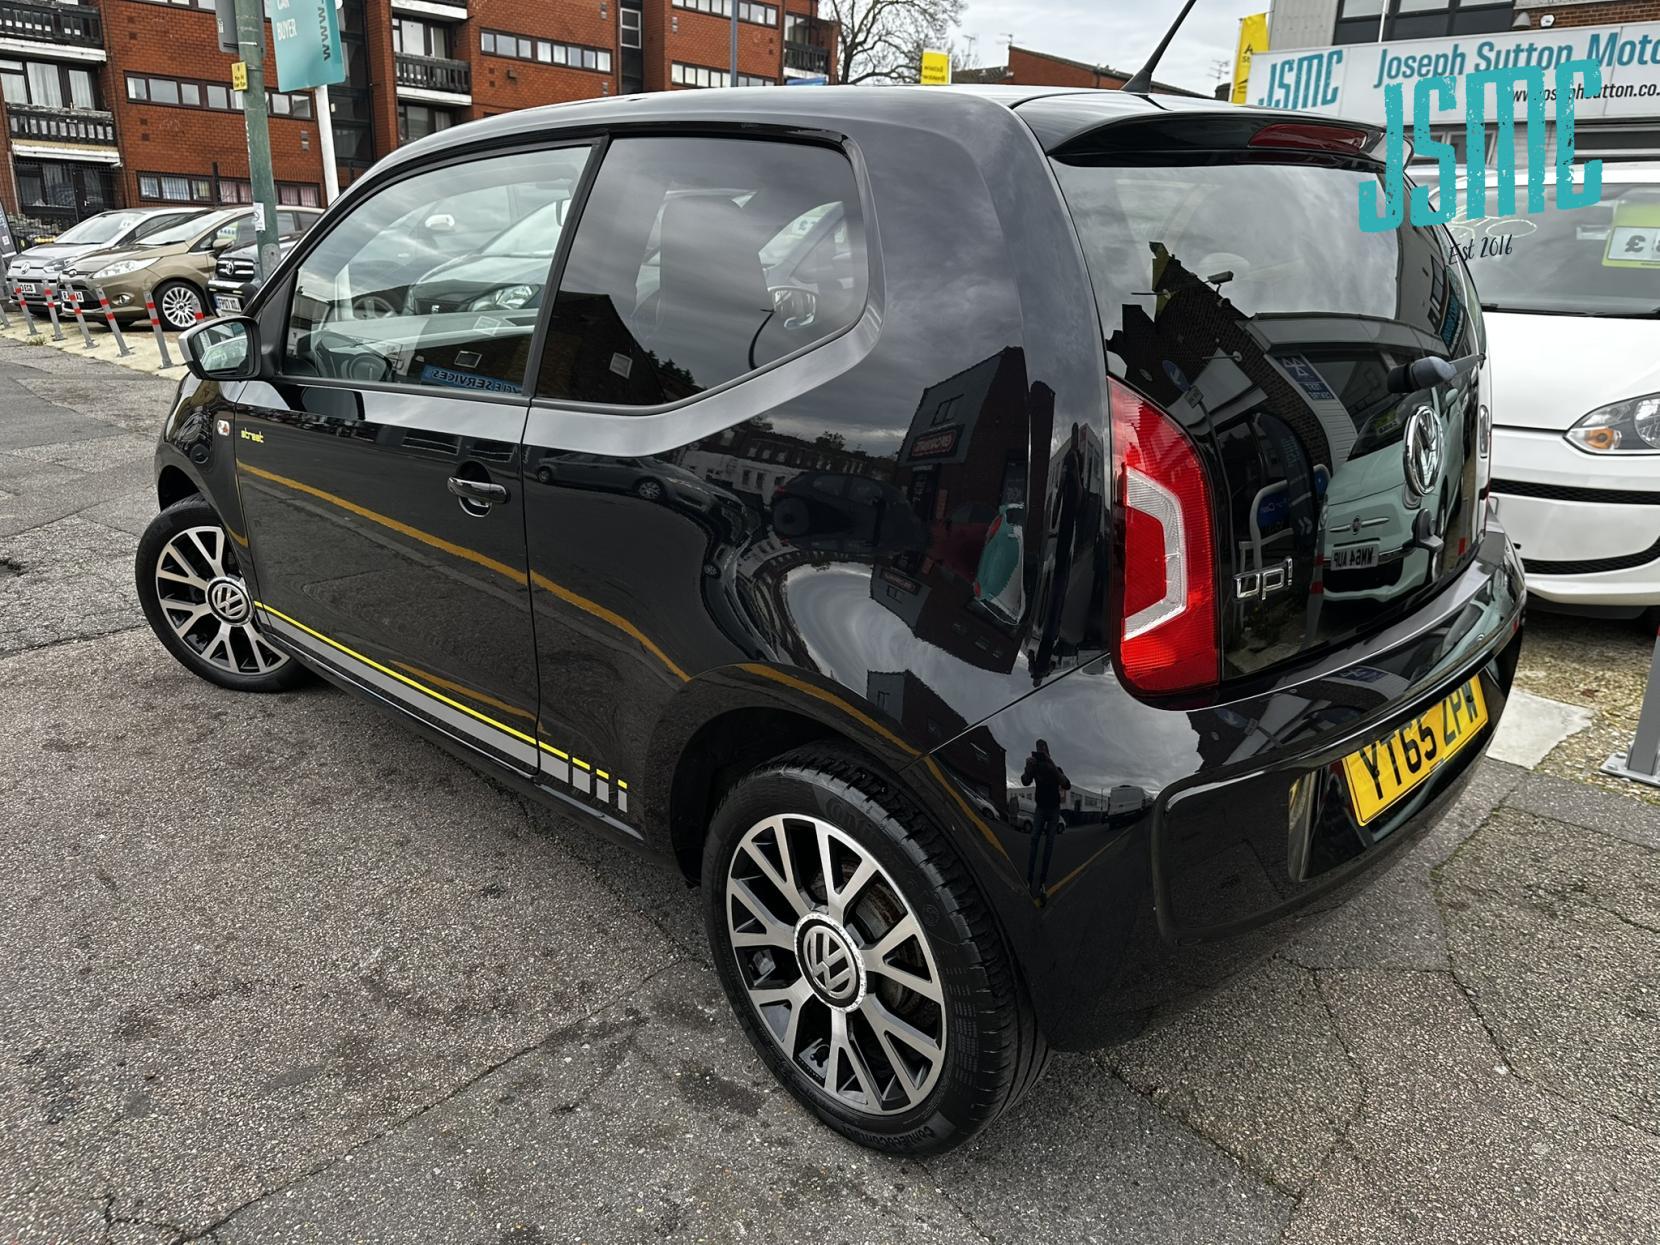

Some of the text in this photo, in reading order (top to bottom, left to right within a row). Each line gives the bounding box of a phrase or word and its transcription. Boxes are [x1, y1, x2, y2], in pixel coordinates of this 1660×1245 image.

[276, 18, 297, 41] BUYER
[1258, 49, 1343, 110] JSMC
[1373, 43, 1466, 89] Joseph
[1474, 41, 1573, 72] Sutton
[240, 427, 264, 443] street
[1236, 557, 1293, 600] up!
[1358, 717, 1437, 800] YT65
